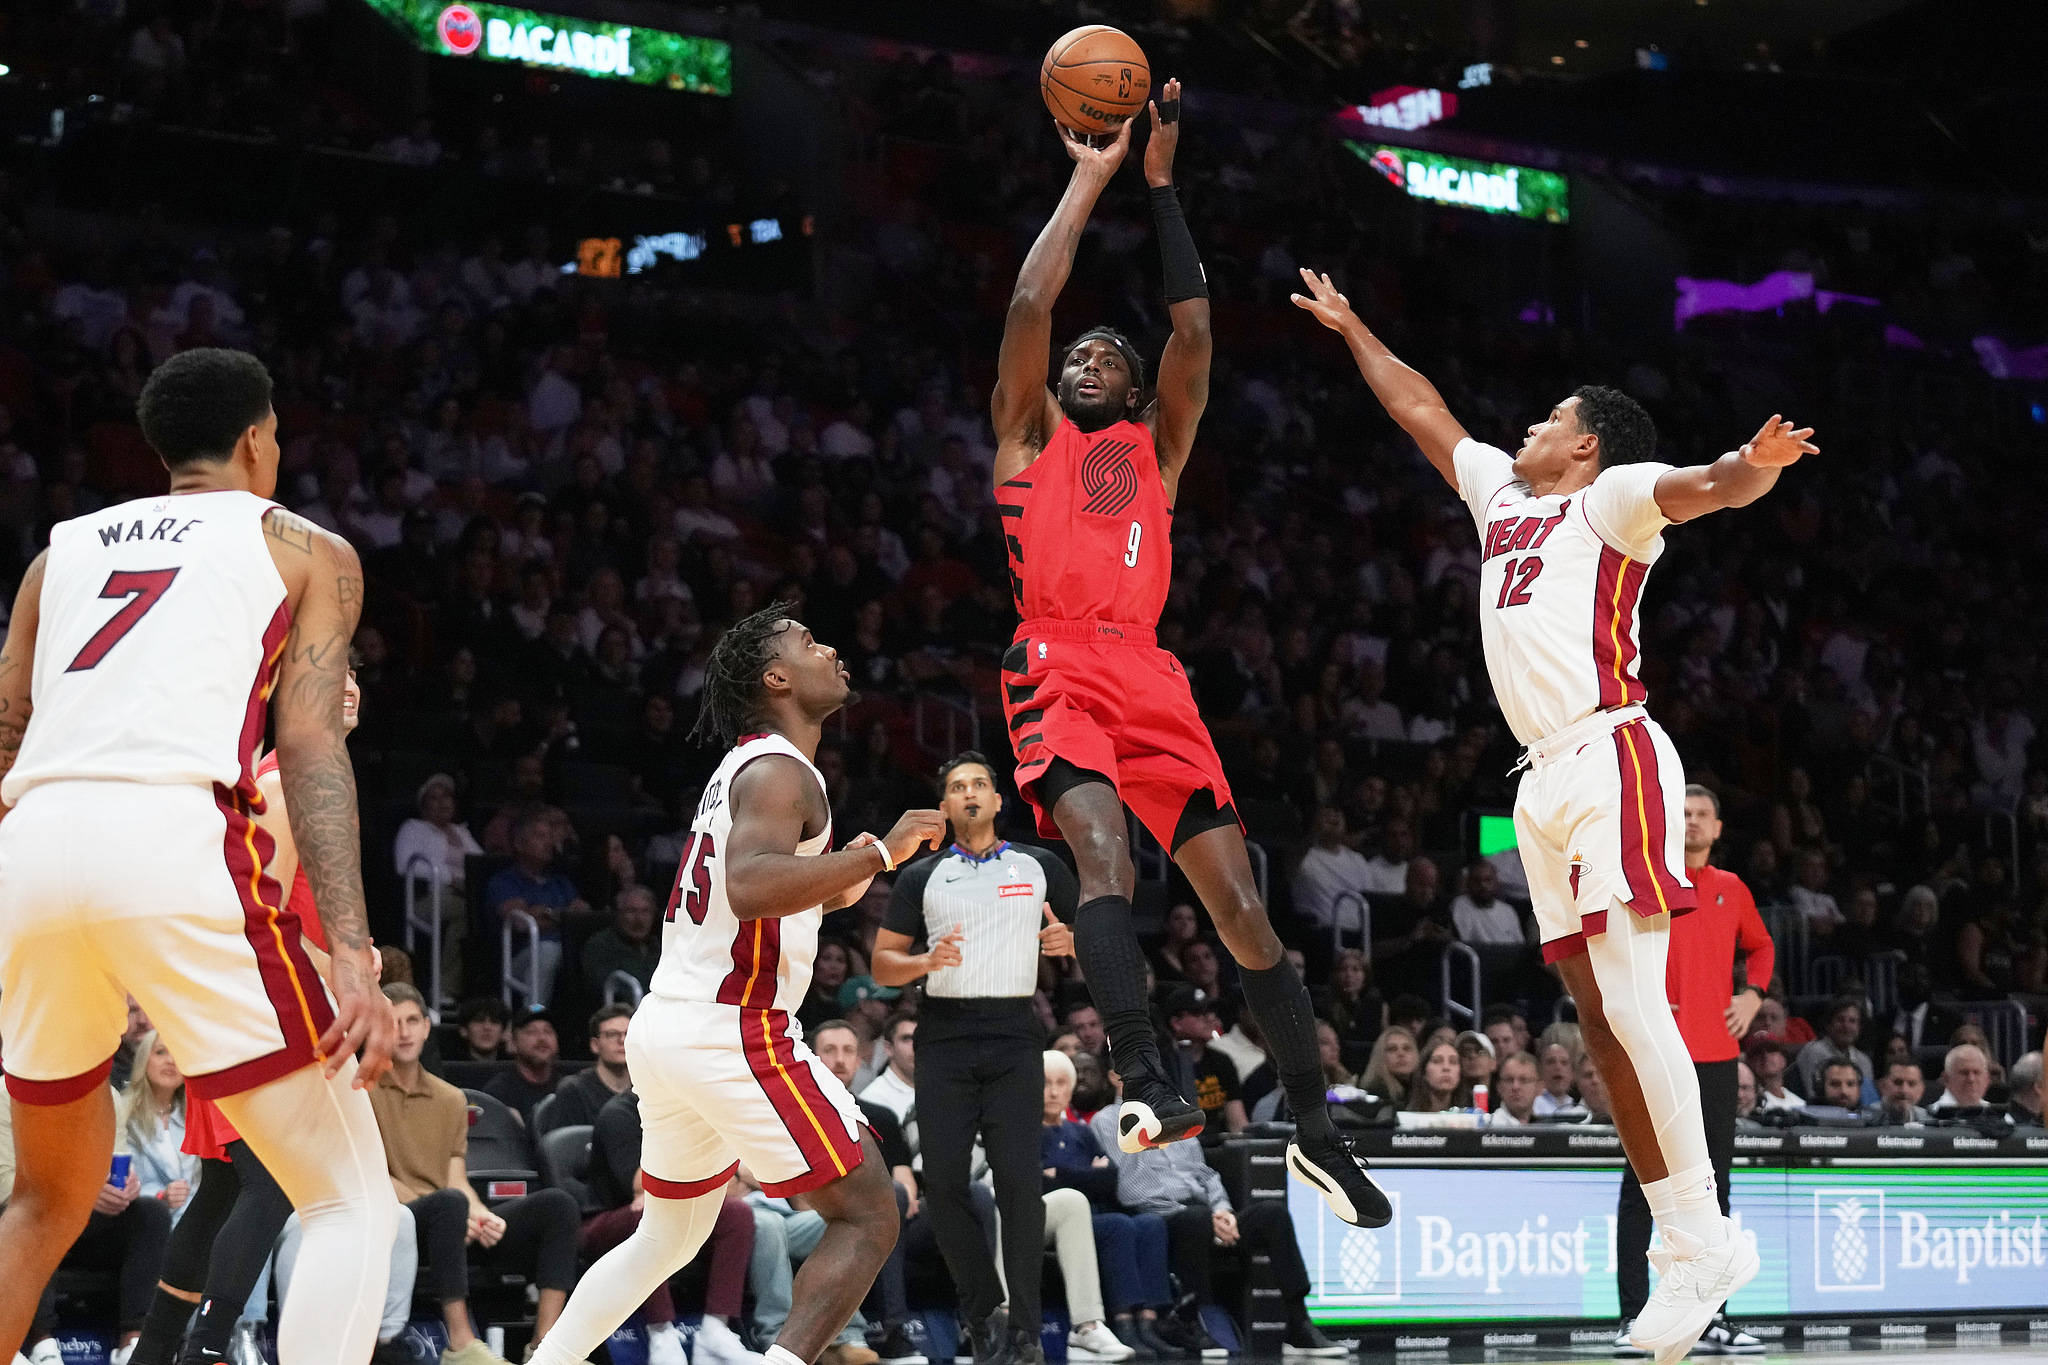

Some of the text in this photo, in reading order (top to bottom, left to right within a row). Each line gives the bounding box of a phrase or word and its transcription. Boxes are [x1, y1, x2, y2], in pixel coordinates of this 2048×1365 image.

[98, 518, 203, 548] WARE
[1124, 520, 1142, 568] 9
[1481, 499, 1571, 565] HEAT
[1496, 556, 1544, 609] 12
[63, 566, 182, 674] 7
[1391, 1134, 1447, 1148] ticketmaster
[1481, 1133, 1536, 1147] ticketmaster
[1734, 1133, 1783, 1149] ticketmaster
[1799, 1133, 1849, 1148] ticketmaster
[1876, 1134, 1925, 1149] ticketmaster
[1953, 1136, 1999, 1149] ticketmaster
[1415, 1213, 1590, 1294] Baptist
[1896, 1209, 2048, 1285] Baptist
